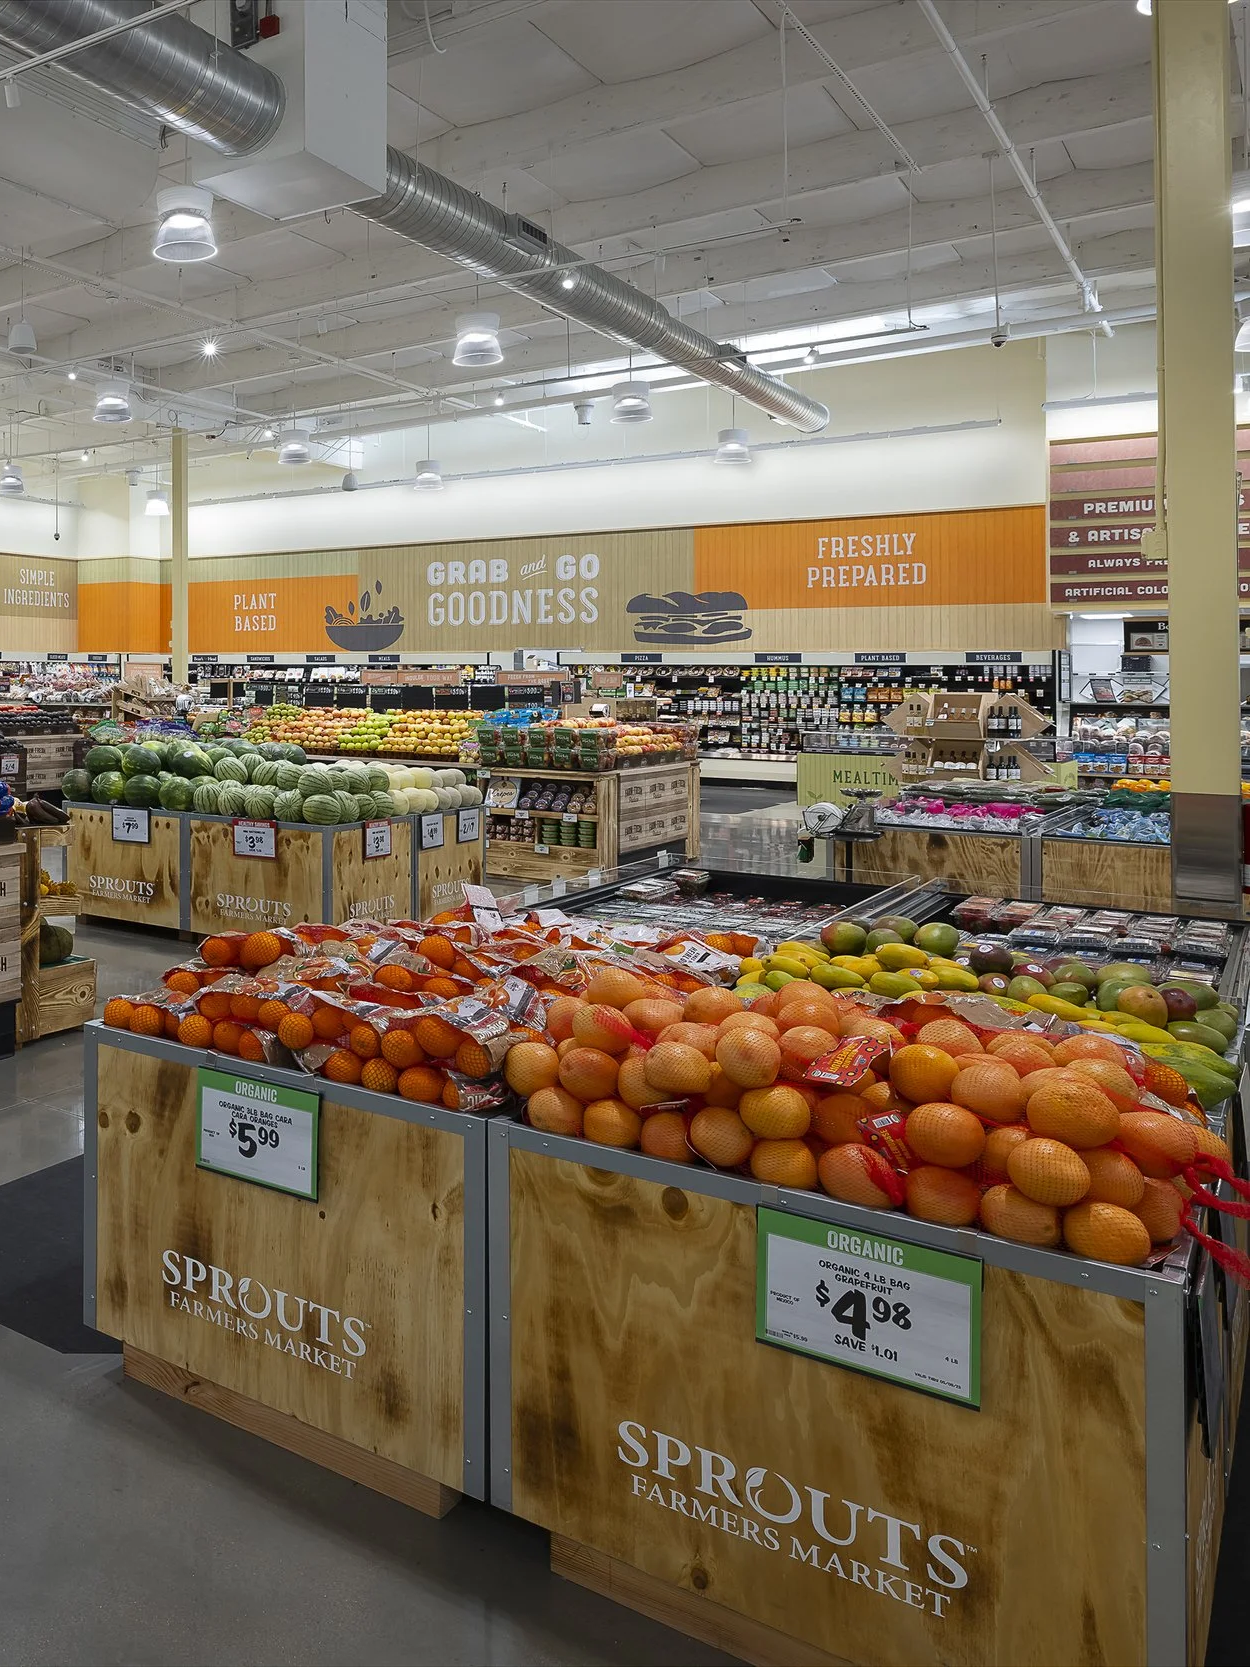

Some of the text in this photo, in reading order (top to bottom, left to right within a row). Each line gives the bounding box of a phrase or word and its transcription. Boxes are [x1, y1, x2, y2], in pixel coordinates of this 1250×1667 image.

[1084, 499, 1155, 515] PREMIU
[817, 532, 916, 558] FRESHLY
[1068, 527, 1153, 543] & ARTIS
[426, 553, 600, 587] GRAB and GO
[1088, 558, 1141, 568] ALWAYS
[19, 568, 55, 587] SIMPLE
[807, 563, 927, 588] PREPARED
[4, 588, 70, 608] INGREDIENTS
[233, 592, 277, 611] PLANT
[1065, 585, 1169, 597] ARTIFICIAL COLO
[427, 586, 599, 627] GOODNESS
[234, 615, 277, 632] BASED
[833, 770, 899, 786] MEALTIM
[89, 875, 154, 896] SPROUTS
[92, 889, 151, 904] FARMERS MARKET
[217, 892, 292, 917] SPROUTS
[349, 895, 395, 918] SPROUTS
[219, 908, 287, 925] FARMERS MARKET
[235, 1081, 278, 1103] ORGANIC
[218, 1100, 293, 1125] ORGANIC 3LB BAG CARA
[231, 1111, 278, 1128] CARA ORANGES
[827, 1230, 904, 1266] ORGANIC
[818, 1259, 911, 1291] ORGANIC 4 LB BAG
[834, 1273, 894, 1296] GRAPEFRUIT
[161, 1249, 367, 1357] SPROUTS
[770, 1290, 792, 1300] PRODUCT
[776, 1297, 794, 1305] MEXICO
[169, 1291, 357, 1380] FARMERS MARKET
[834, 1333, 898, 1362] SAVE $1.01
[617, 1420, 969, 1590] SPROUTS
[630, 1473, 951, 1619] FARMERS MARKET
